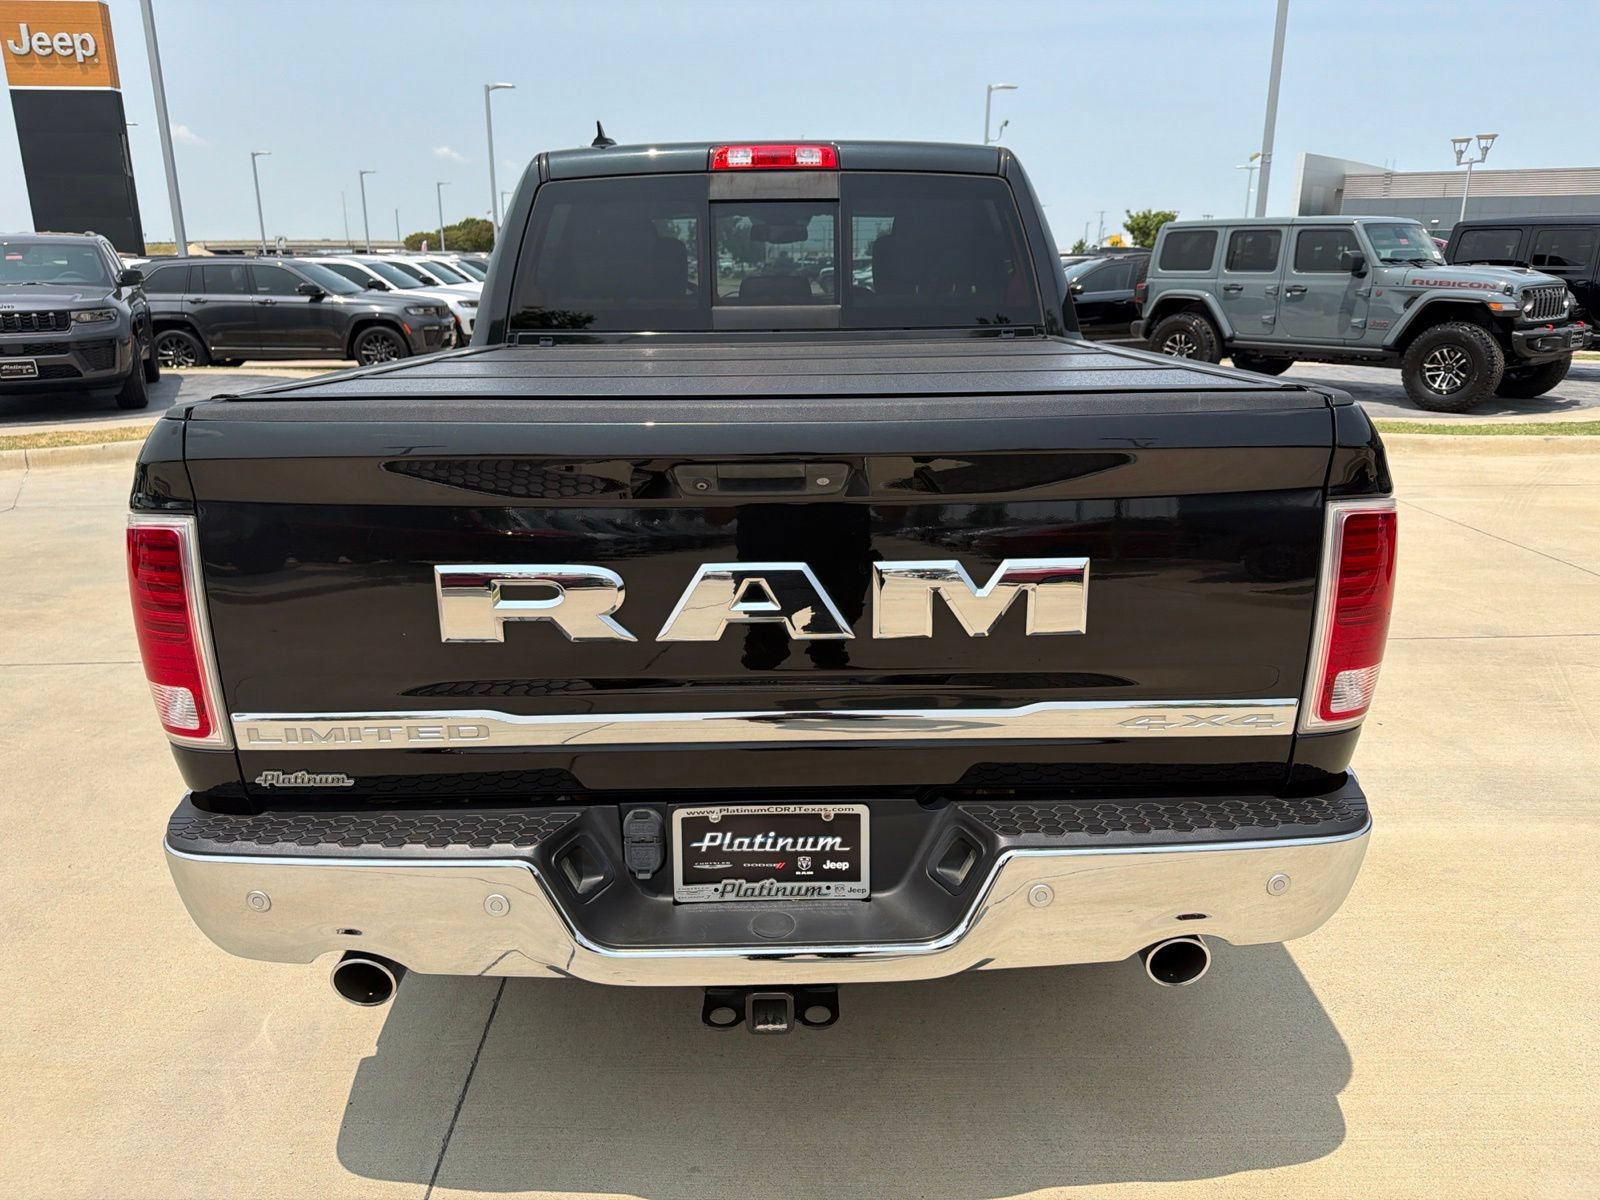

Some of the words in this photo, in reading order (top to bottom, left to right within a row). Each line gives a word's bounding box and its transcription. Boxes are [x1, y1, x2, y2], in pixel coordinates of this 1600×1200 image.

[6, 23, 97, 63] Jeep
[1411, 278, 1498, 290] RUBICON
[433, 557, 1091, 643] RAM
[246, 724, 491, 744] LIMITED
[255, 771, 355, 787] Platinum
[686, 806, 855, 816] www.PlatinumCDRJTexas.com
[690, 832, 851, 852] Platinum
[822, 860, 850, 871] Jeep
[719, 880, 831, 898] Platinum
